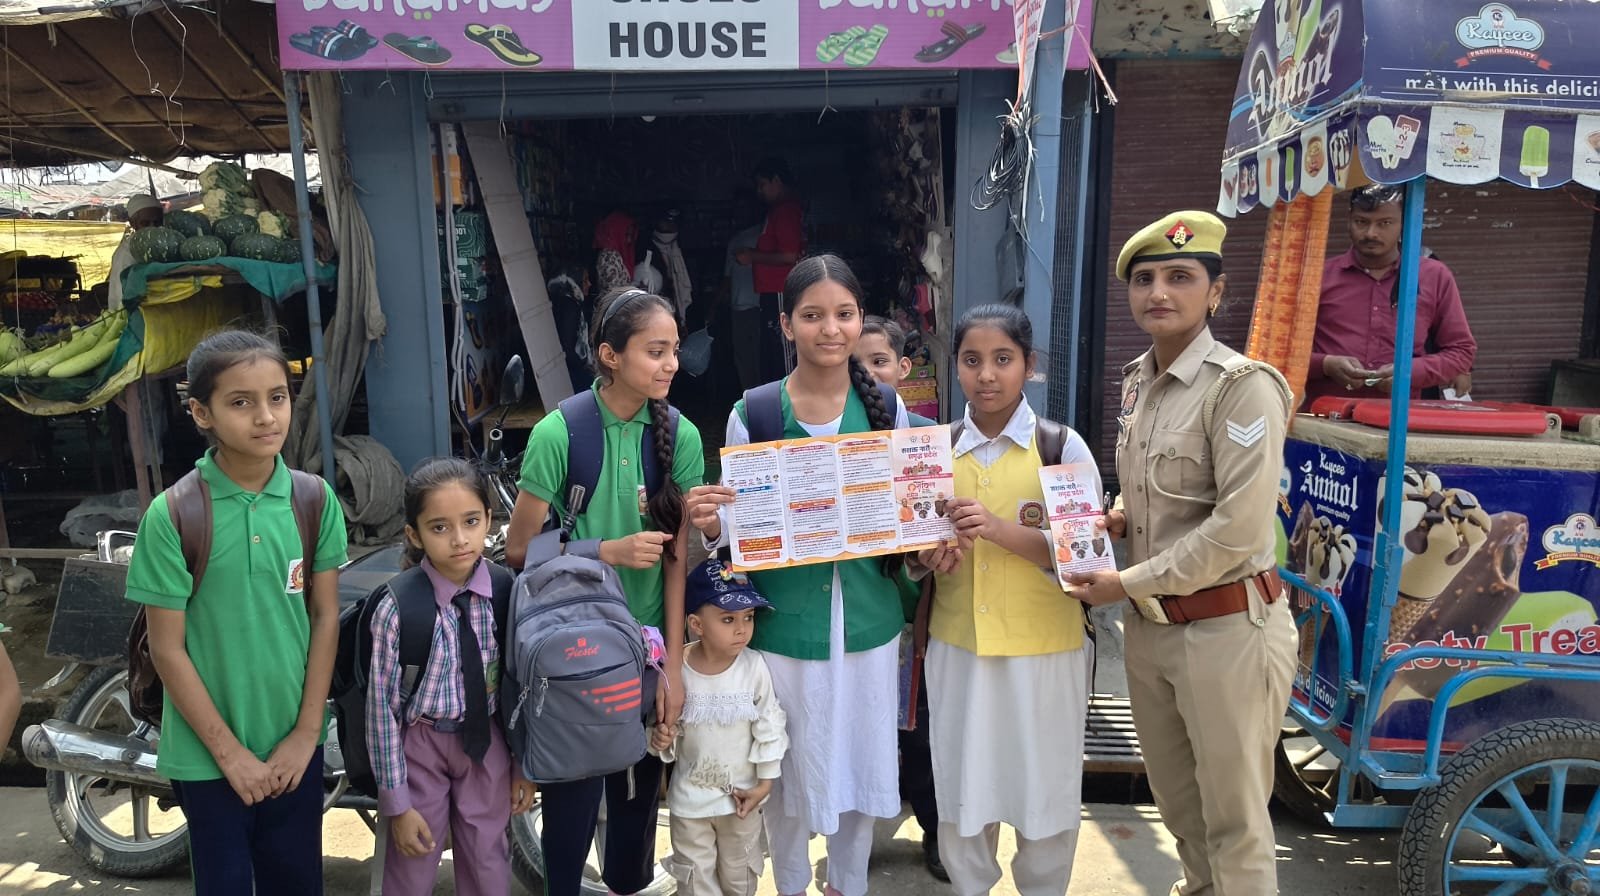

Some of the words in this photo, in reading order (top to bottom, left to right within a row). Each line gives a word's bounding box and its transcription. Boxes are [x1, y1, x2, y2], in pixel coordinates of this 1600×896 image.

[609, 21, 767, 58] HOUSE
[1466, 22, 1535, 48] Kaycee
[1470, 48, 1503, 58] PREMIUM
[1504, 48, 1536, 60] QUALITY
[1453, 76, 1497, 92] with
[1504, 78, 1539, 95] this
[1545, 79, 1600, 97] delici
[1320, 452, 1346, 478] Kaycee
[1300, 473, 1359, 511] Anmol
[1551, 530, 1600, 554] Kayce
[1384, 629, 1489, 672] asty
